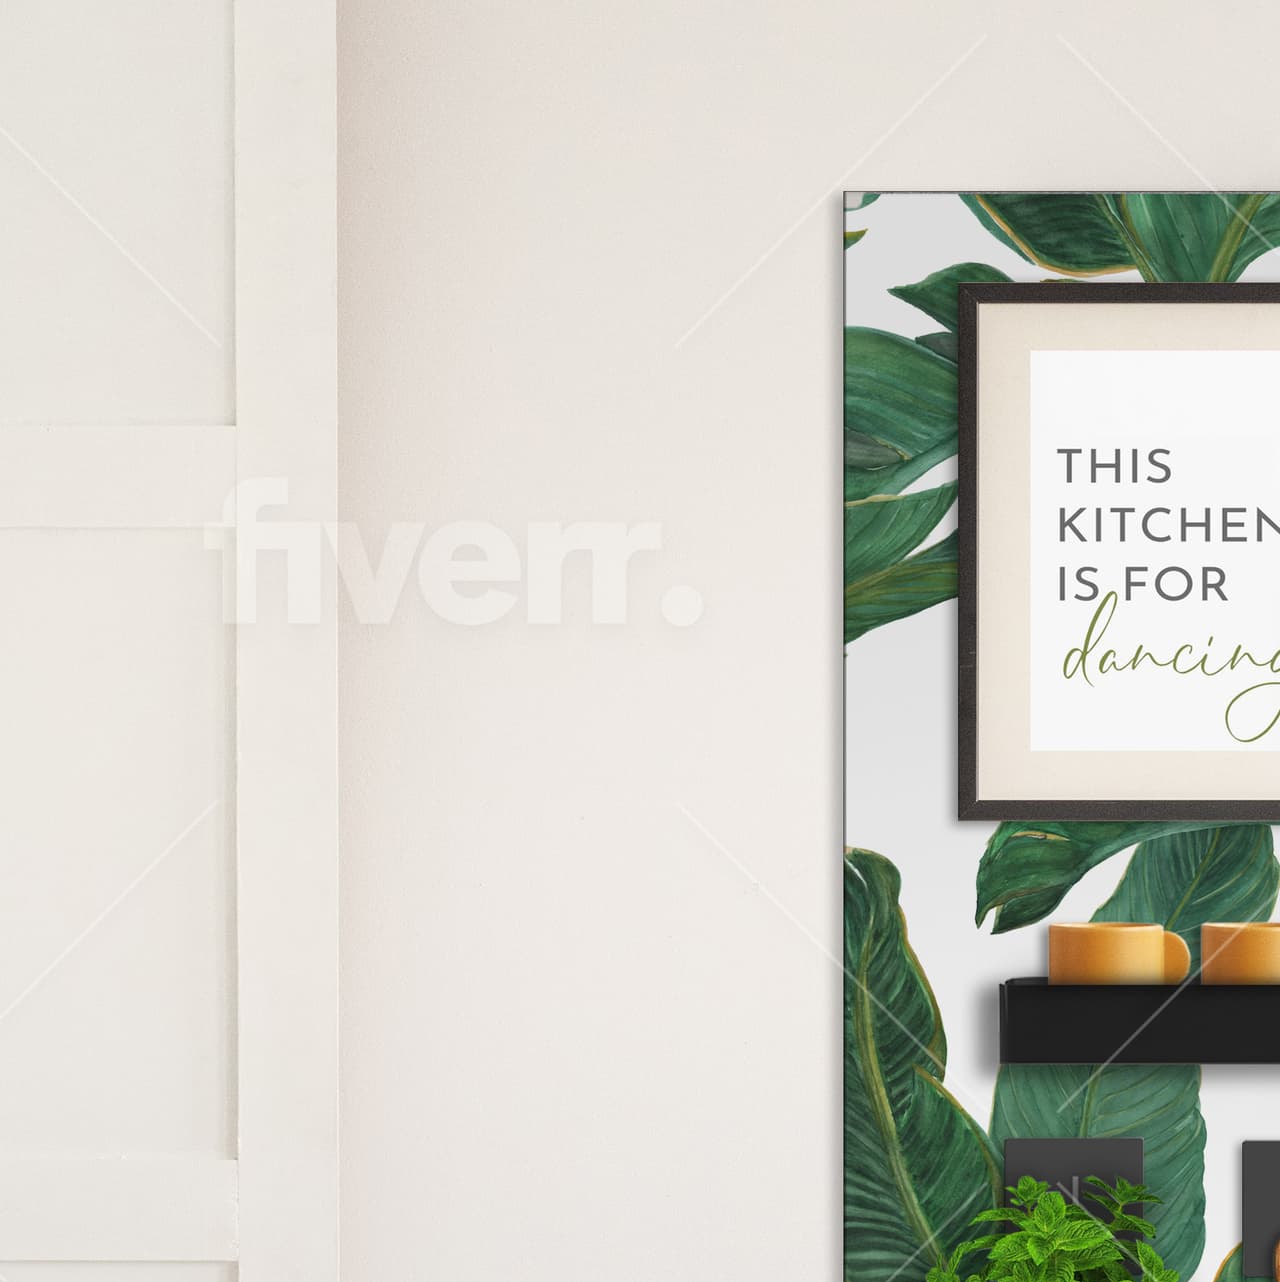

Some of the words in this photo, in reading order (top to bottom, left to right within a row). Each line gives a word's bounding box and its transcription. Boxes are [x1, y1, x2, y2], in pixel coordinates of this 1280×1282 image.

[1055, 446, 1173, 485] THIS
[1058, 565, 1100, 603] IS
[1123, 565, 1230, 603] FOR
